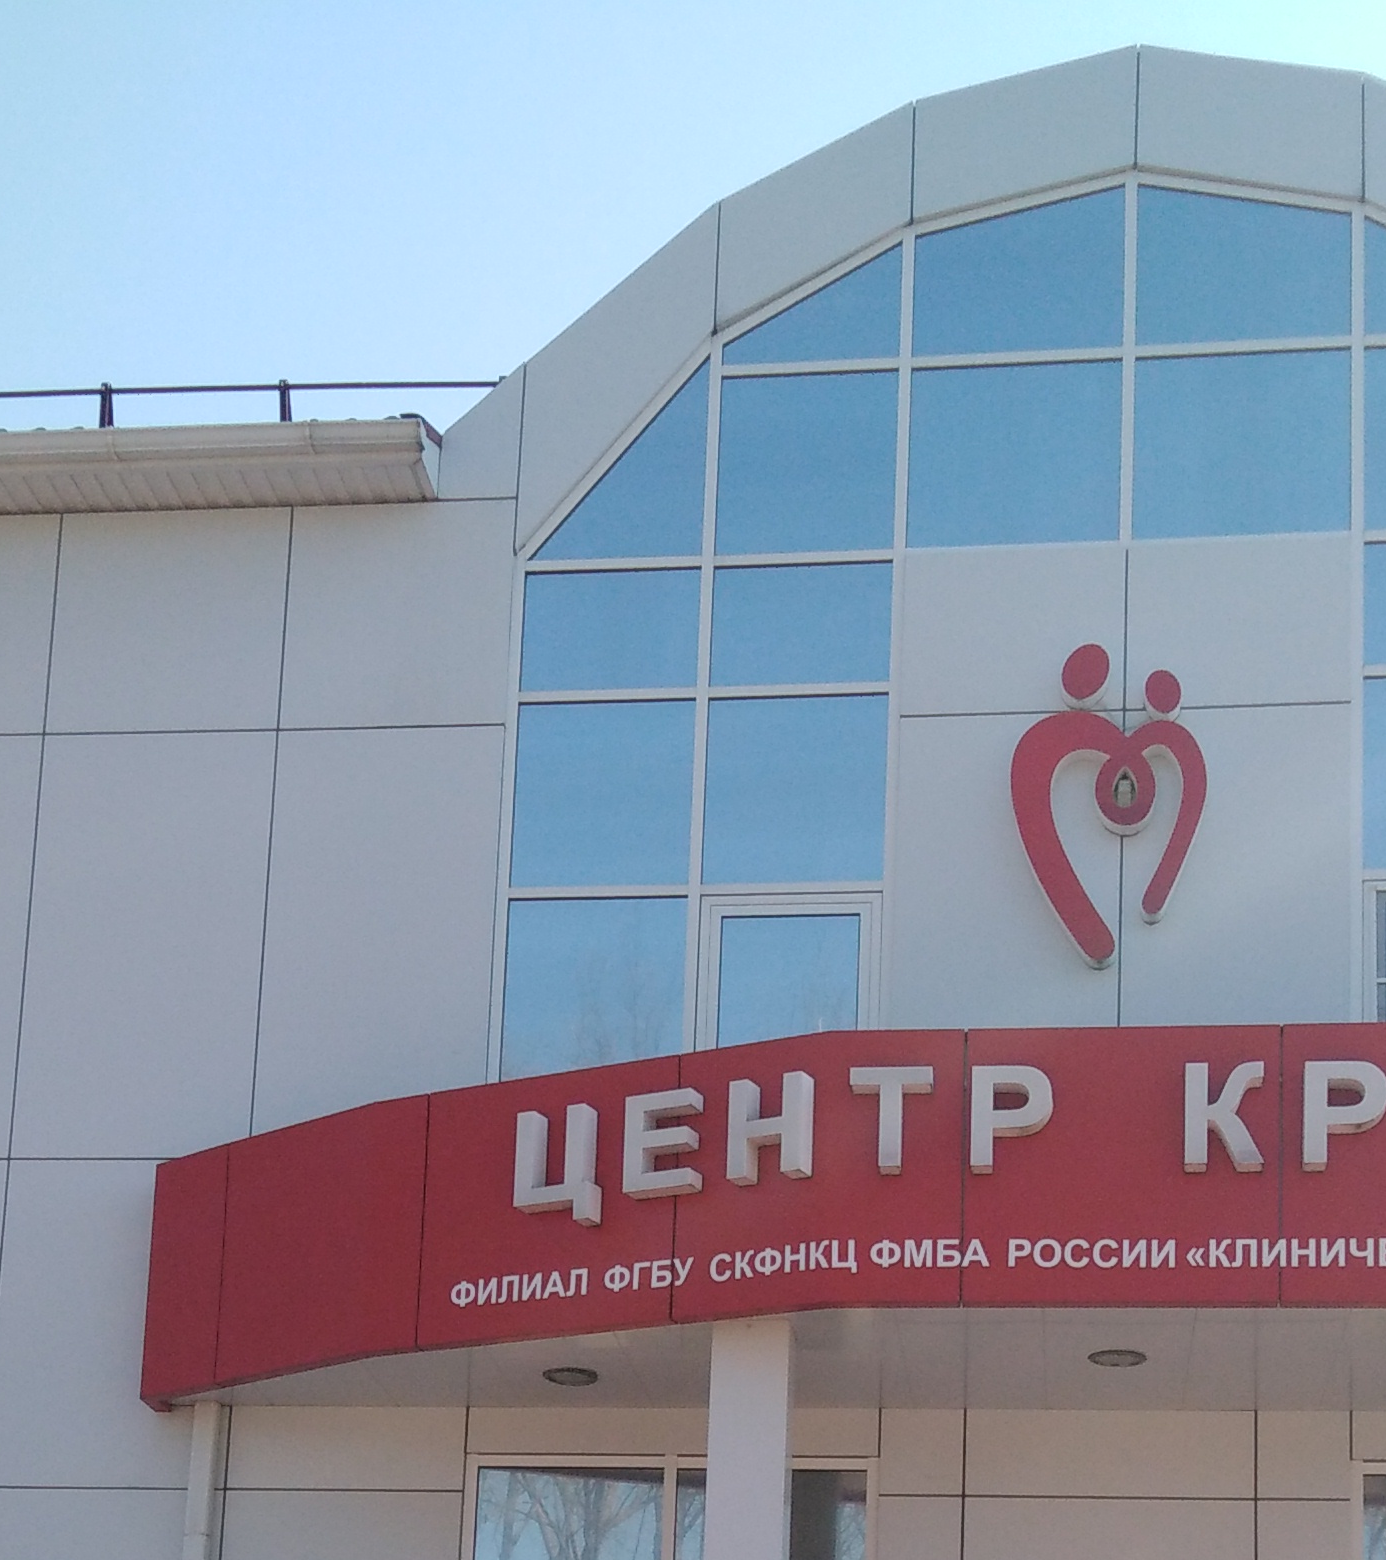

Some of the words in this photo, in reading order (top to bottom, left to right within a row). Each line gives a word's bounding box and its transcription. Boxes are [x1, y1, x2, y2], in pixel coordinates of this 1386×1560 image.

[512, 1064, 1055, 1227] ЦЕНТР
[449, 1267, 589, 1308] ФИЛИАЛ
[602, 1257, 695, 1294] ФГБУ
[708, 1238, 859, 1284] СКФНКЦ
[869, 1237, 990, 1270] ФМБА
[1009, 1238, 1176, 1269] РОССИИ
